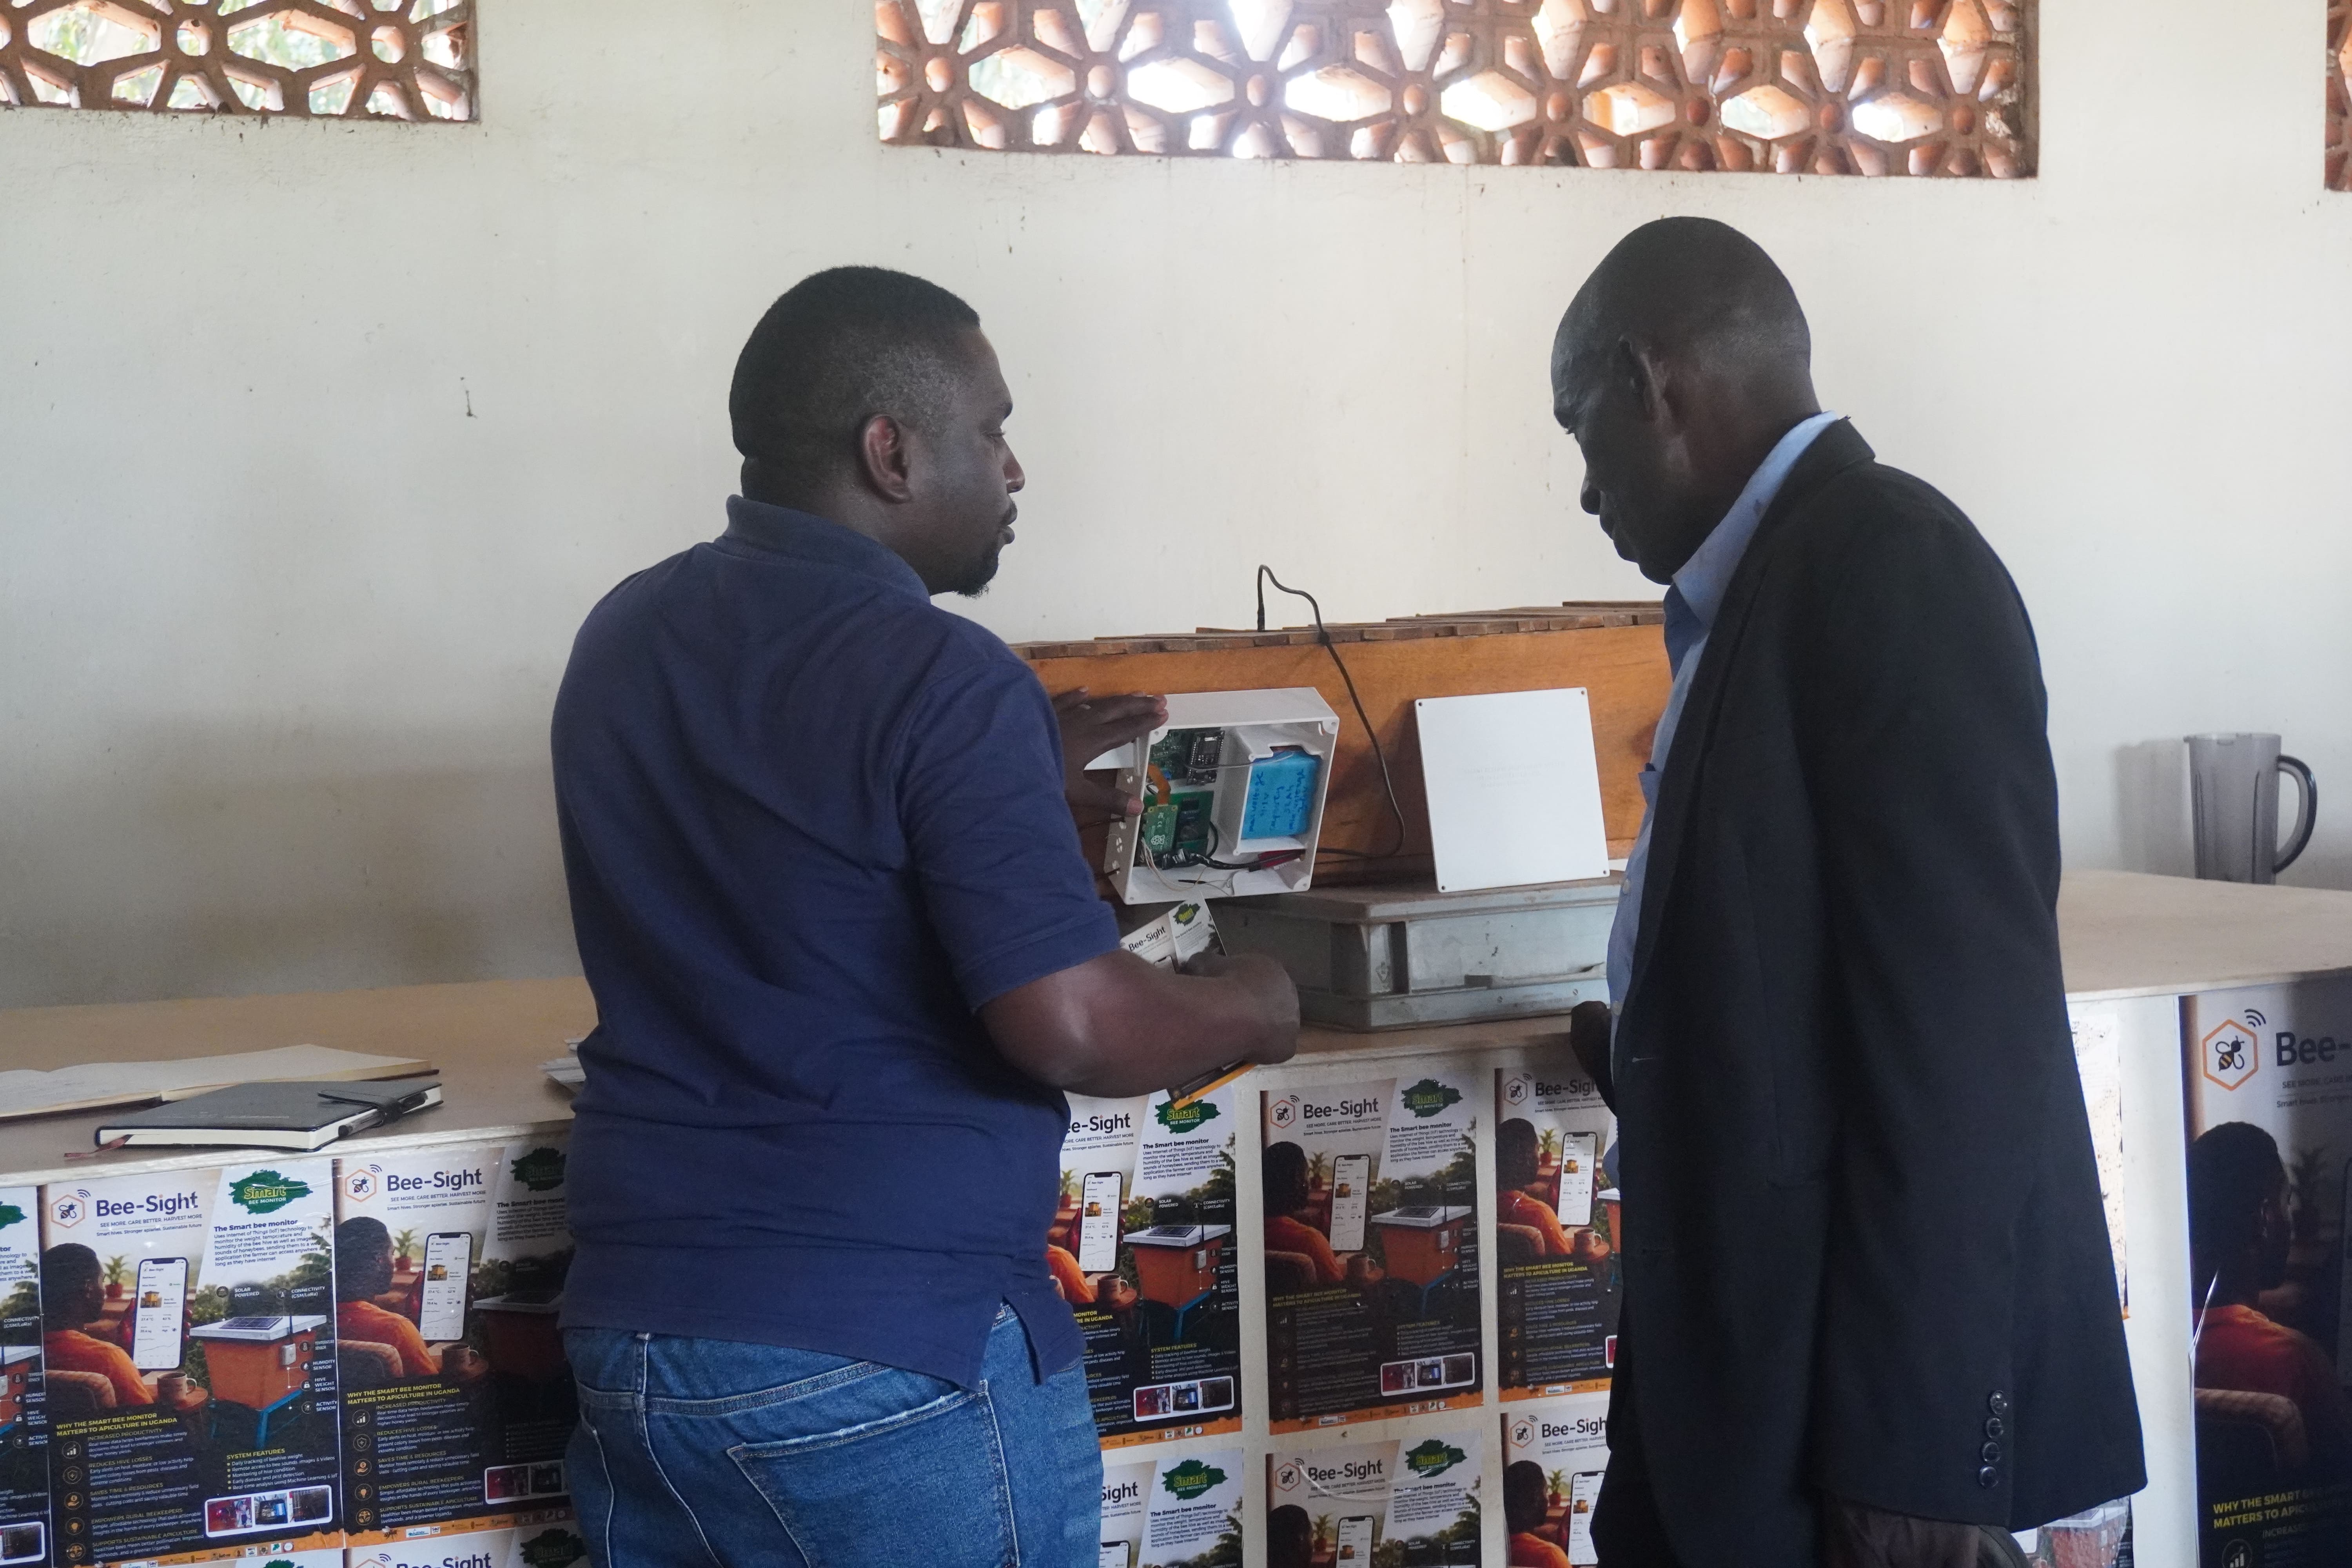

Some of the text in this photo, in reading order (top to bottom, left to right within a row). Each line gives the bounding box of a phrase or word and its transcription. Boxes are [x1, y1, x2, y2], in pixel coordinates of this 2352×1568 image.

[1129, 926, 1165, 951] Bee-Sight
[1167, 1107, 1200, 1120] Smart
[1304, 1098, 1378, 1118] Bee-Sight
[388, 1169, 482, 1191] Bee-Sight
[243, 1185, 286, 1200] Smart
[96, 1191, 198, 1216] Bee-Sight
[387, 1392, 425, 1401] APICULTURE
[127, 1412, 156, 1421] MONITOR
[57, 1428, 88, 1436] MATTERS
[99, 1422, 139, 1431] APICULTURE
[149, 1417, 177, 1425] UGANDA
[253, 1448, 285, 1457] FEATURES
[1308, 1459, 1383, 1481] Bee-Sight
[2213, 1501, 2239, 1514] WHY
[2241, 1497, 2262, 1508] THE
[2264, 1490, 2301, 1505] SMART
[2214, 1509, 2279, 1528] MATTERS TO
